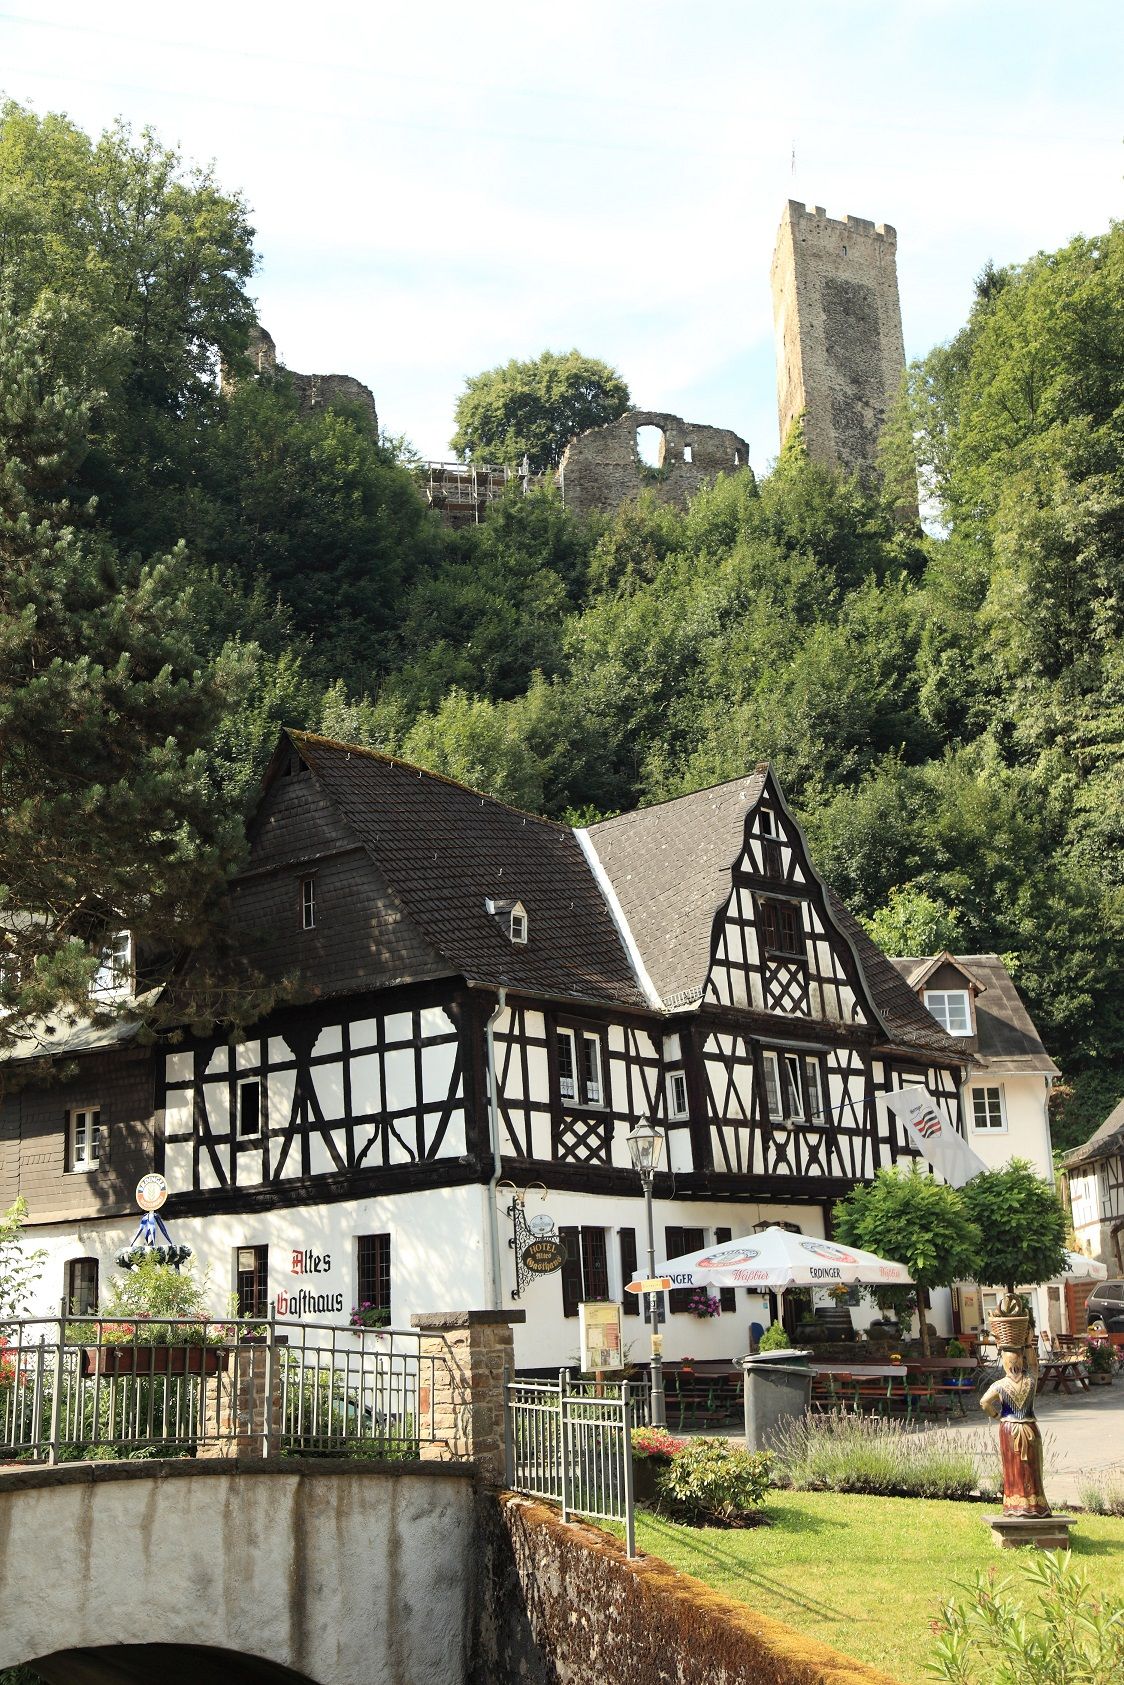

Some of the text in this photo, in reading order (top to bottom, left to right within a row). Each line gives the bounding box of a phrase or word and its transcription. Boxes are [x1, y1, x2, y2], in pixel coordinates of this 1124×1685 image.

[530, 1243, 556, 1254] HOTEL
[291, 1249, 331, 1275] Altes
[809, 1267, 842, 1279] ERDINGER
